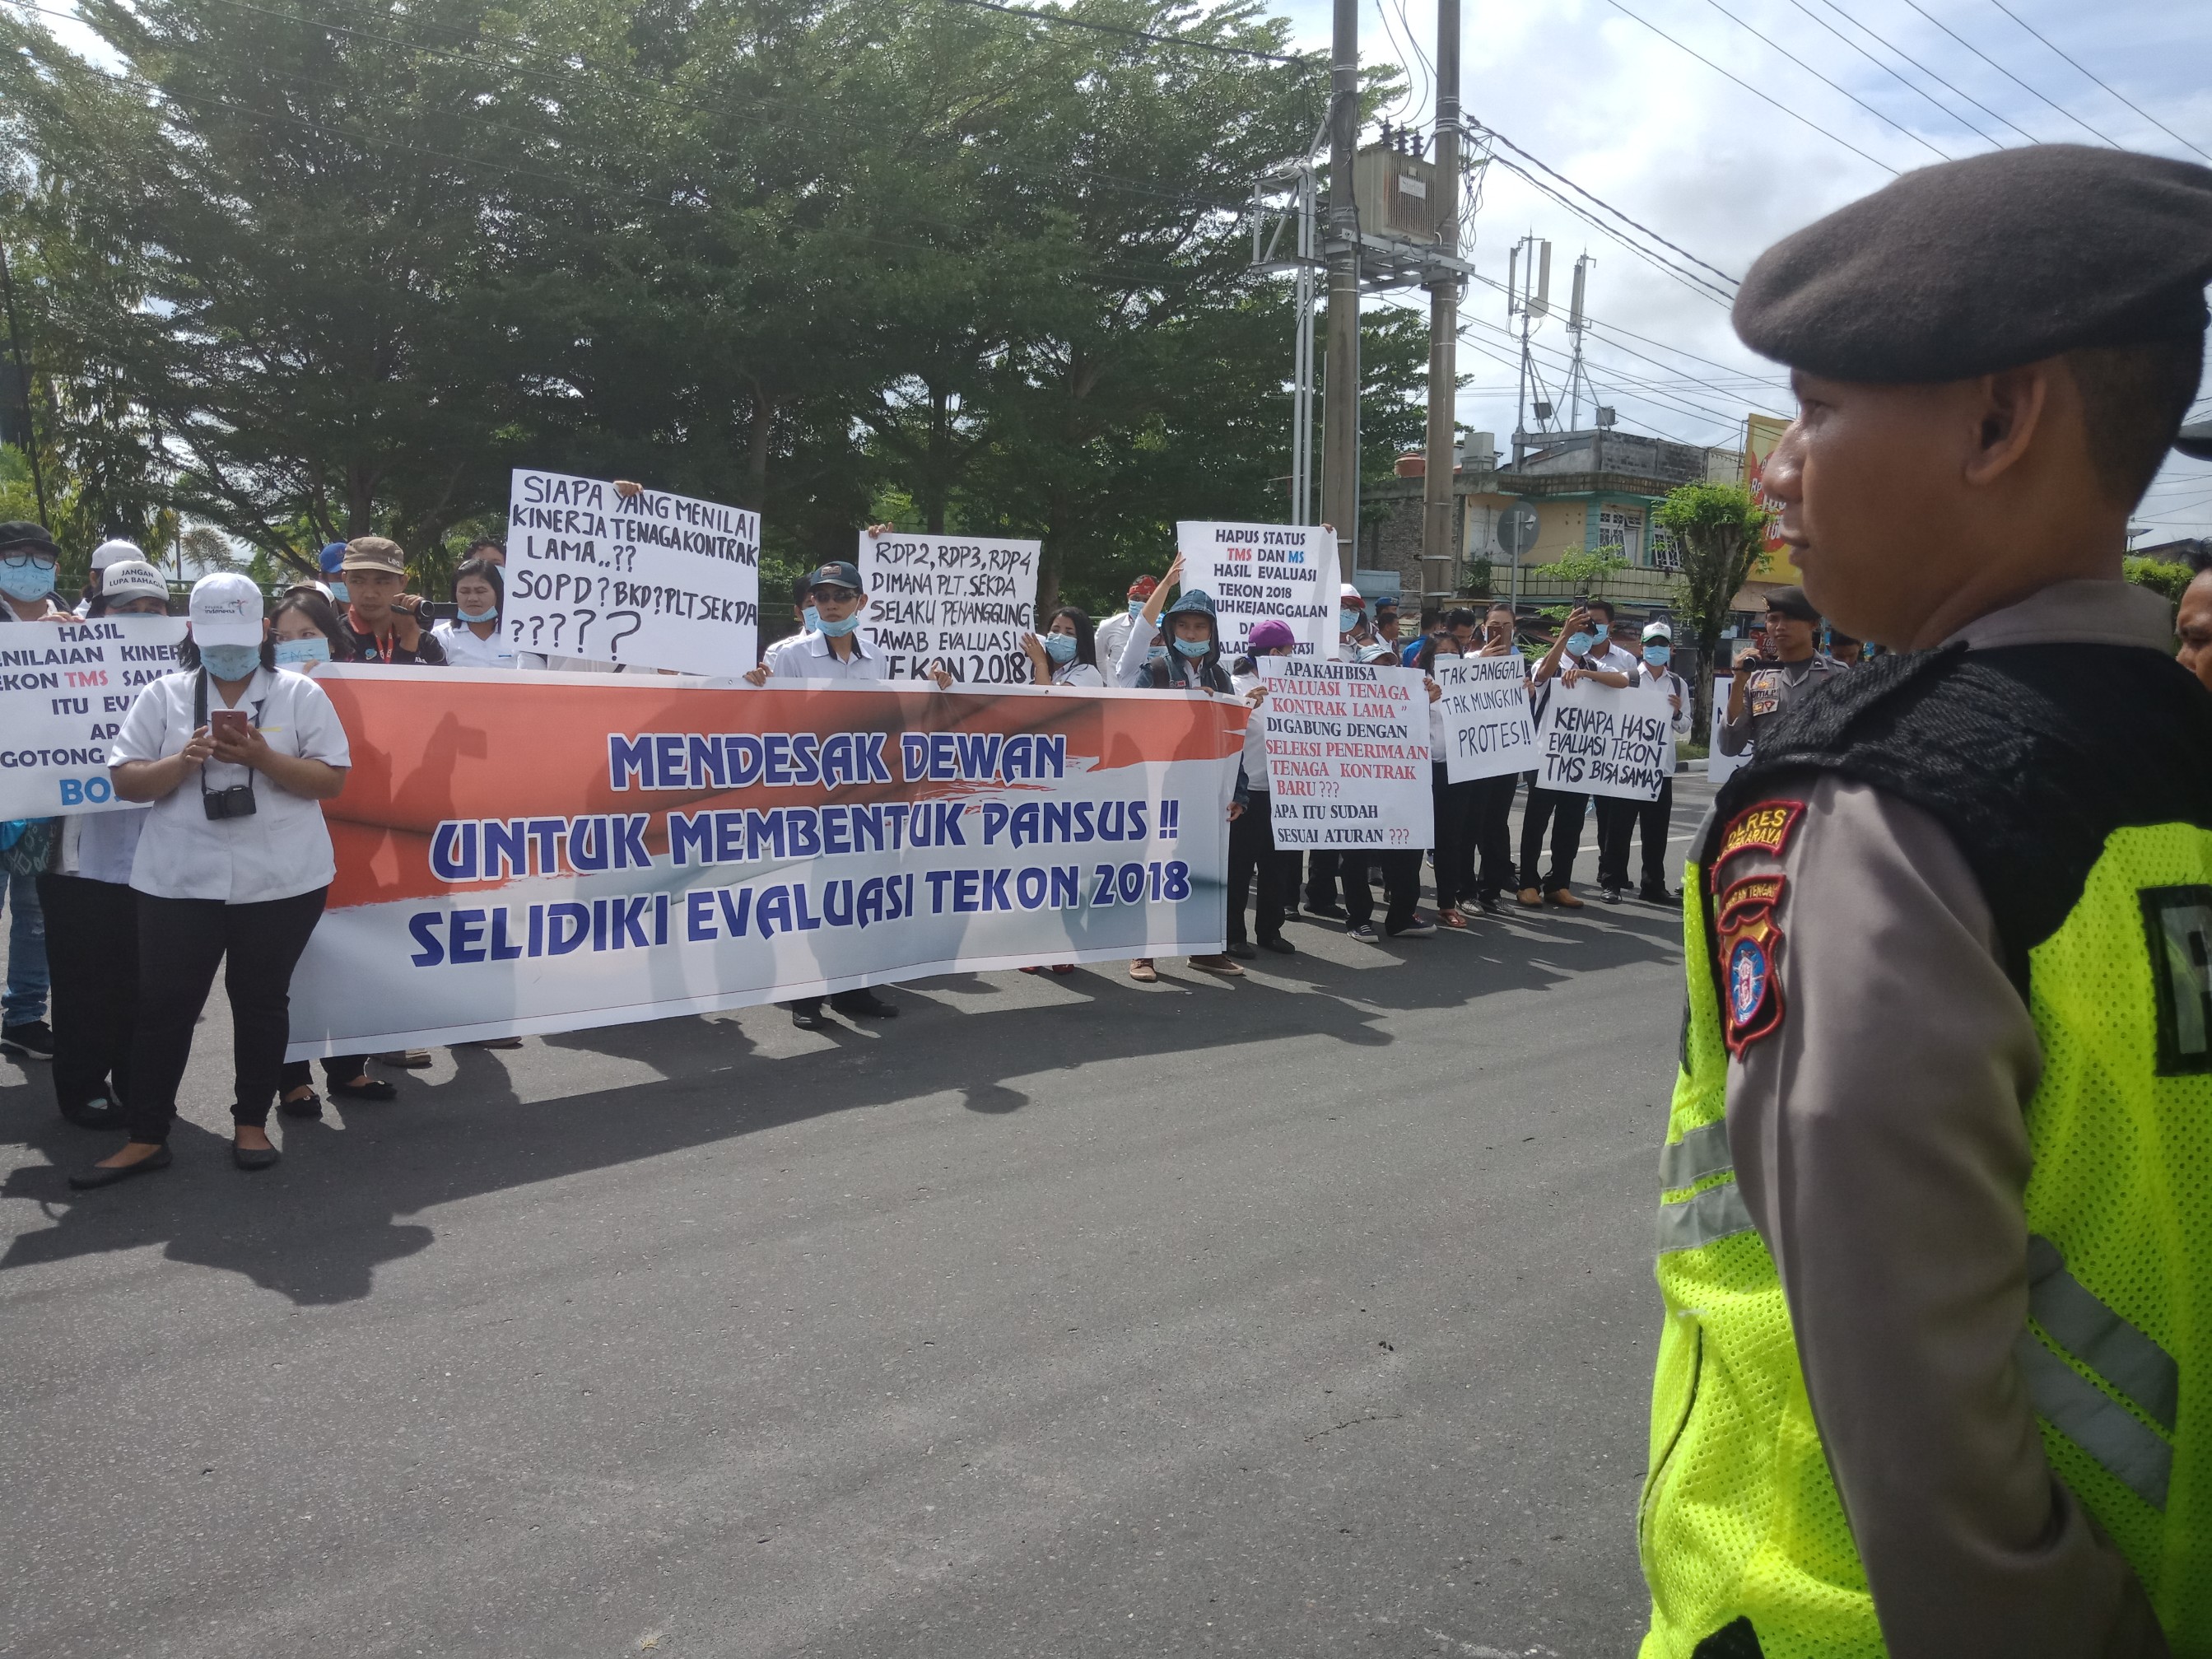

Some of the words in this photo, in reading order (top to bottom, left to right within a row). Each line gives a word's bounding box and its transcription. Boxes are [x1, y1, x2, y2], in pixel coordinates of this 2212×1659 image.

[524, 476, 603, 510] SIAPA
[613, 488, 672, 519] YANG
[675, 500, 754, 541] MENILAI
[512, 504, 607, 538] KINERJA
[1216, 529, 1260, 543] HAPUS
[1264, 532, 1306, 545] STATUS
[989, 549, 1032, 576] RDP4
[1227, 548, 1251, 562] TMS
[1258, 549, 1284, 562] DAN
[1288, 551, 1305, 564] MS
[109, 578, 129, 587] LUPA
[131, 576, 165, 590] BAHAGIA
[122, 569, 154, 577] JANGAN
[1214, 564, 1251, 577] HASIL
[1258, 566, 1317, 581] EVALUASI
[871, 571, 933, 595] DIMANA
[969, 574, 1017, 599] SEKDA
[1218, 583, 1263, 599] TEKON
[1266, 587, 1292, 599] 2018
[696, 595, 757, 626] SEKDA
[869, 599, 937, 626] SELAKU
[941, 600, 1031, 630] PENANGGUNG
[58, 623, 125, 642] HASIL
[863, 627, 929, 652] JAWAB
[938, 631, 1018, 651] EVALUASI
[0, 646, 104, 667] NILAIAN
[64, 670, 109, 688] TMS
[886, 655, 965, 683] EKON
[968, 653, 1036, 684] 2018
[1284, 661, 1343, 679] APAKAH
[1344, 666, 1377, 681] BISA
[1440, 666, 1468, 686] TAK
[1470, 660, 1523, 682] JANGGAL
[1348, 683, 1410, 701] TENAGA
[1442, 695, 1470, 715] TAK
[1470, 688, 1523, 711] MUNGKIN
[52, 697, 89, 715] ITU
[1272, 697, 1347, 716] KONTRAK
[1353, 702, 1396, 719] LAMA
[1267, 716, 1342, 737] DIGABUNG
[1347, 723, 1408, 739] DENGAN
[1555, 706, 1614, 738] KENAPA
[1621, 714, 1668, 746] HASIL
[0, 748, 105, 767] GOTONG
[1265, 739, 1321, 757] SELEKSI
[1325, 742, 1429, 760] PENERIMAAN
[1548, 731, 1607, 757] EVALUASI
[1611, 738, 1662, 768] TEKON
[611, 734, 888, 788] MENDESAK
[903, 735, 1064, 783] DEWAN
[1270, 760, 1330, 776] TENAGA
[1340, 763, 1417, 780] KONTRAK
[1545, 753, 1585, 782] TMS
[1588, 760, 1619, 782] BISA
[59, 776, 123, 806] BO
[1274, 804, 1298, 818] APA
[1302, 805, 1325, 819] ITU
[1330, 804, 1378, 819] SUDAH
[433, 817, 651, 878] UNTUK
[671, 804, 966, 864] MEMBENTUK
[983, 801, 1147, 849] PANSUS
[1278, 827, 1319, 843] SESUAI
[1324, 828, 1383, 843] ATURAN
[410, 895, 668, 967] SELIDIKI
[687, 874, 913, 944] EVALUASI
[925, 867, 1078, 912] TEKON
[1090, 861, 1190, 905] 2018
